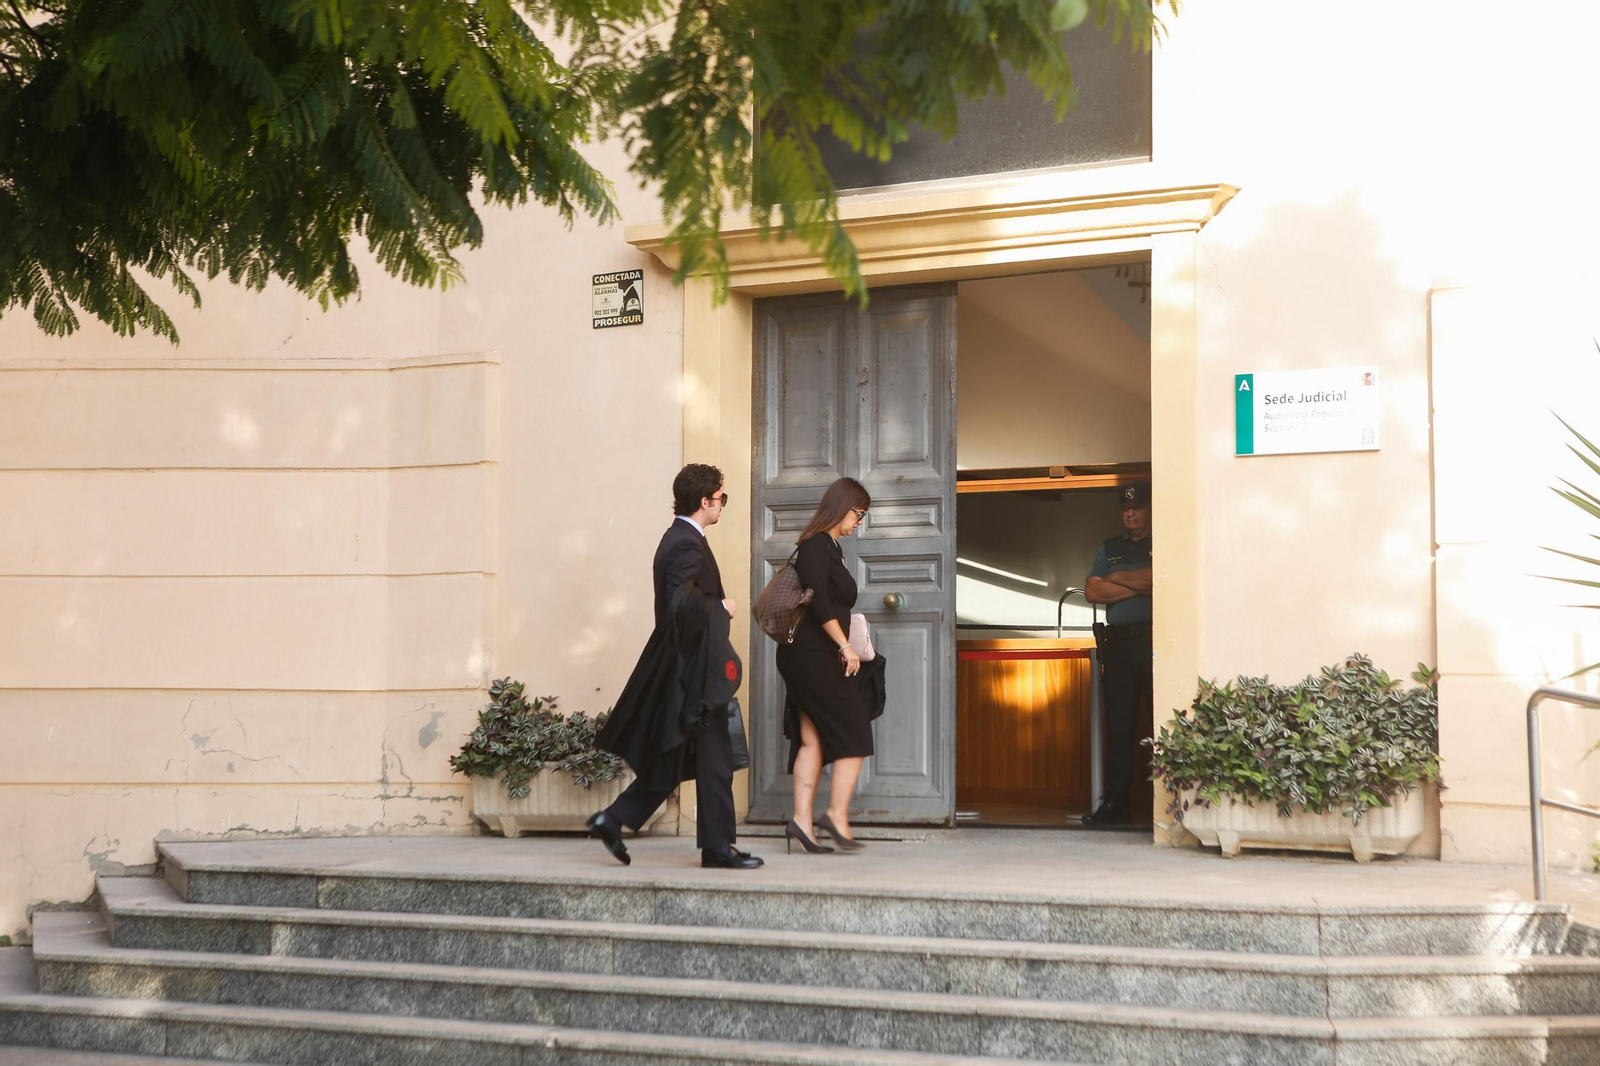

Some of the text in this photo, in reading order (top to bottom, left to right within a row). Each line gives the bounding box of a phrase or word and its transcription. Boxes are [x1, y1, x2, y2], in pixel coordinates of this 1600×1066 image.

[594, 271, 641, 284] CONECTADA
[594, 315, 641, 327] PROSEGUR
[1264, 390, 1347, 405] Sede Judicial
[1263, 408, 1357, 420] Audiencia Provincal
